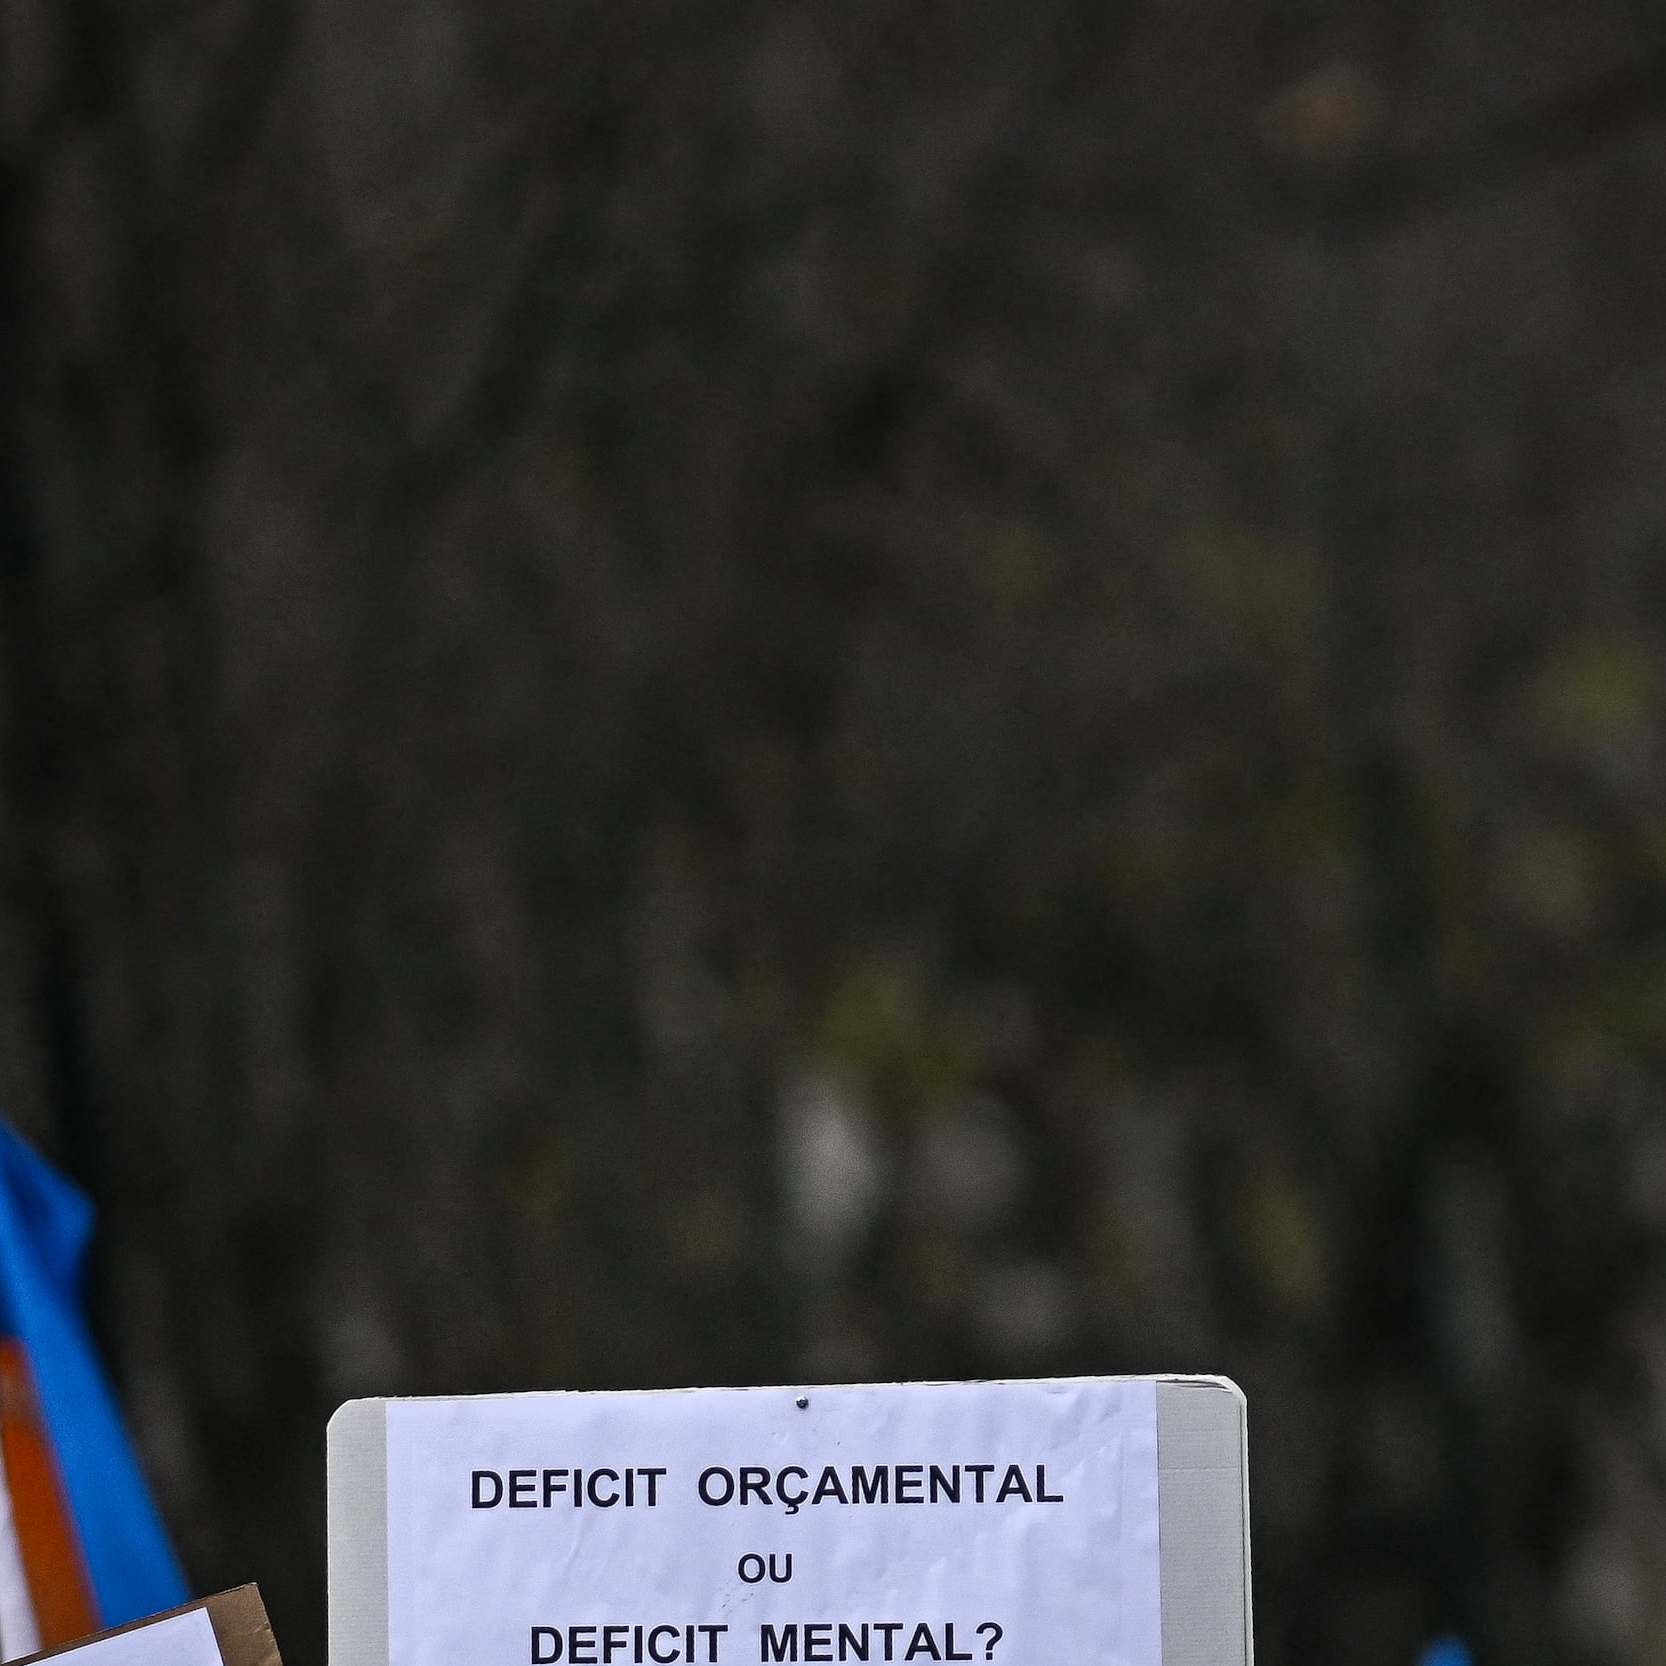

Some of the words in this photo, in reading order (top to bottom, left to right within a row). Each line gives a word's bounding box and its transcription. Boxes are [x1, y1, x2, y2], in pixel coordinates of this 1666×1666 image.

[471, 1467, 667, 1509] DEFICIT
[698, 1464, 1064, 1516] ORÇAMENTAL
[738, 1553, 793, 1585] OU
[531, 1624, 729, 1666] DEFICIT
[760, 1622, 1004, 1663] MENTAL?
